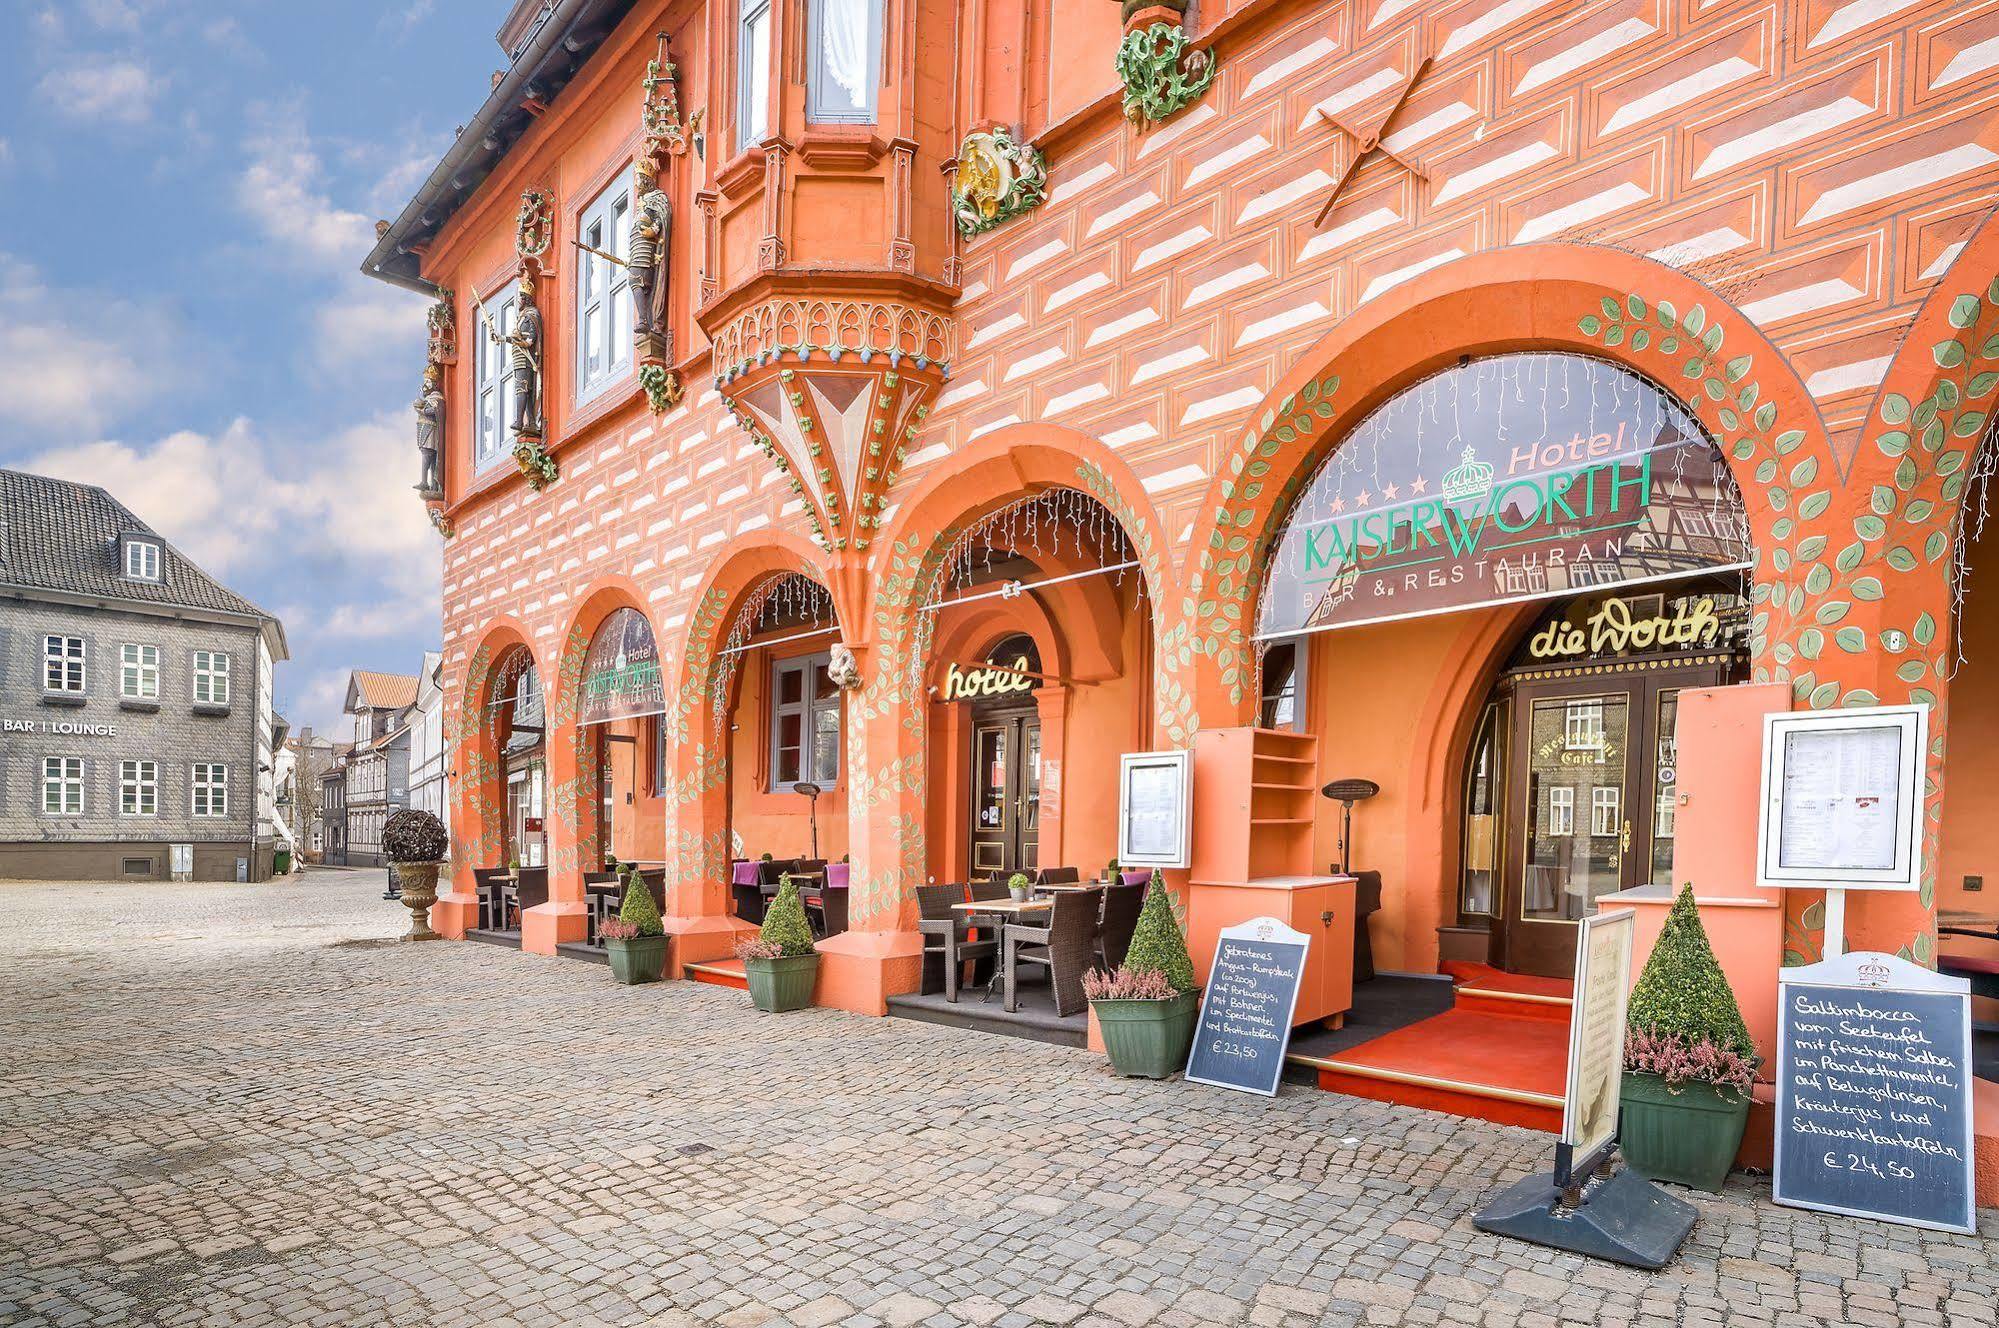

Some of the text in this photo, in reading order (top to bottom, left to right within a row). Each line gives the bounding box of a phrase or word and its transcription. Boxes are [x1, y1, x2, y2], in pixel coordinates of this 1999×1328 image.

[1507, 421, 1627, 475] Hotel
[1304, 452, 1651, 572] KAISERWORTH
[1303, 533, 1651, 608] BAR & RESTAURANT
[1530, 598, 1719, 658] die Worth
[628, 645, 652, 662] Hotel
[945, 656, 1032, 700] hotel
[3, 719, 35, 732] BAR
[52, 721, 117, 736] LOUNGE
[1561, 750, 1594, 766] Café
[1214, 983, 1229, 993] auf
[1213, 996, 1265, 1012] mit Bohnen
[1794, 995, 1921, 1023] Saltimbocca
[1206, 1021, 1220, 1031] und
[1794, 1021, 1932, 1044] vom Seeteufel
[1213, 1040, 1222, 1053] €
[1795, 1038, 1956, 1068] mit frischem Salbei
[1794, 1056, 1818, 1069] im
[1795, 1072, 1947, 1112] auf Belugalinsen,
[1794, 1095, 1932, 1126] Kräuterjus und
[1792, 1117, 1963, 1162] Schwenkkartoffeln
[1823, 1152, 1843, 1168] €
